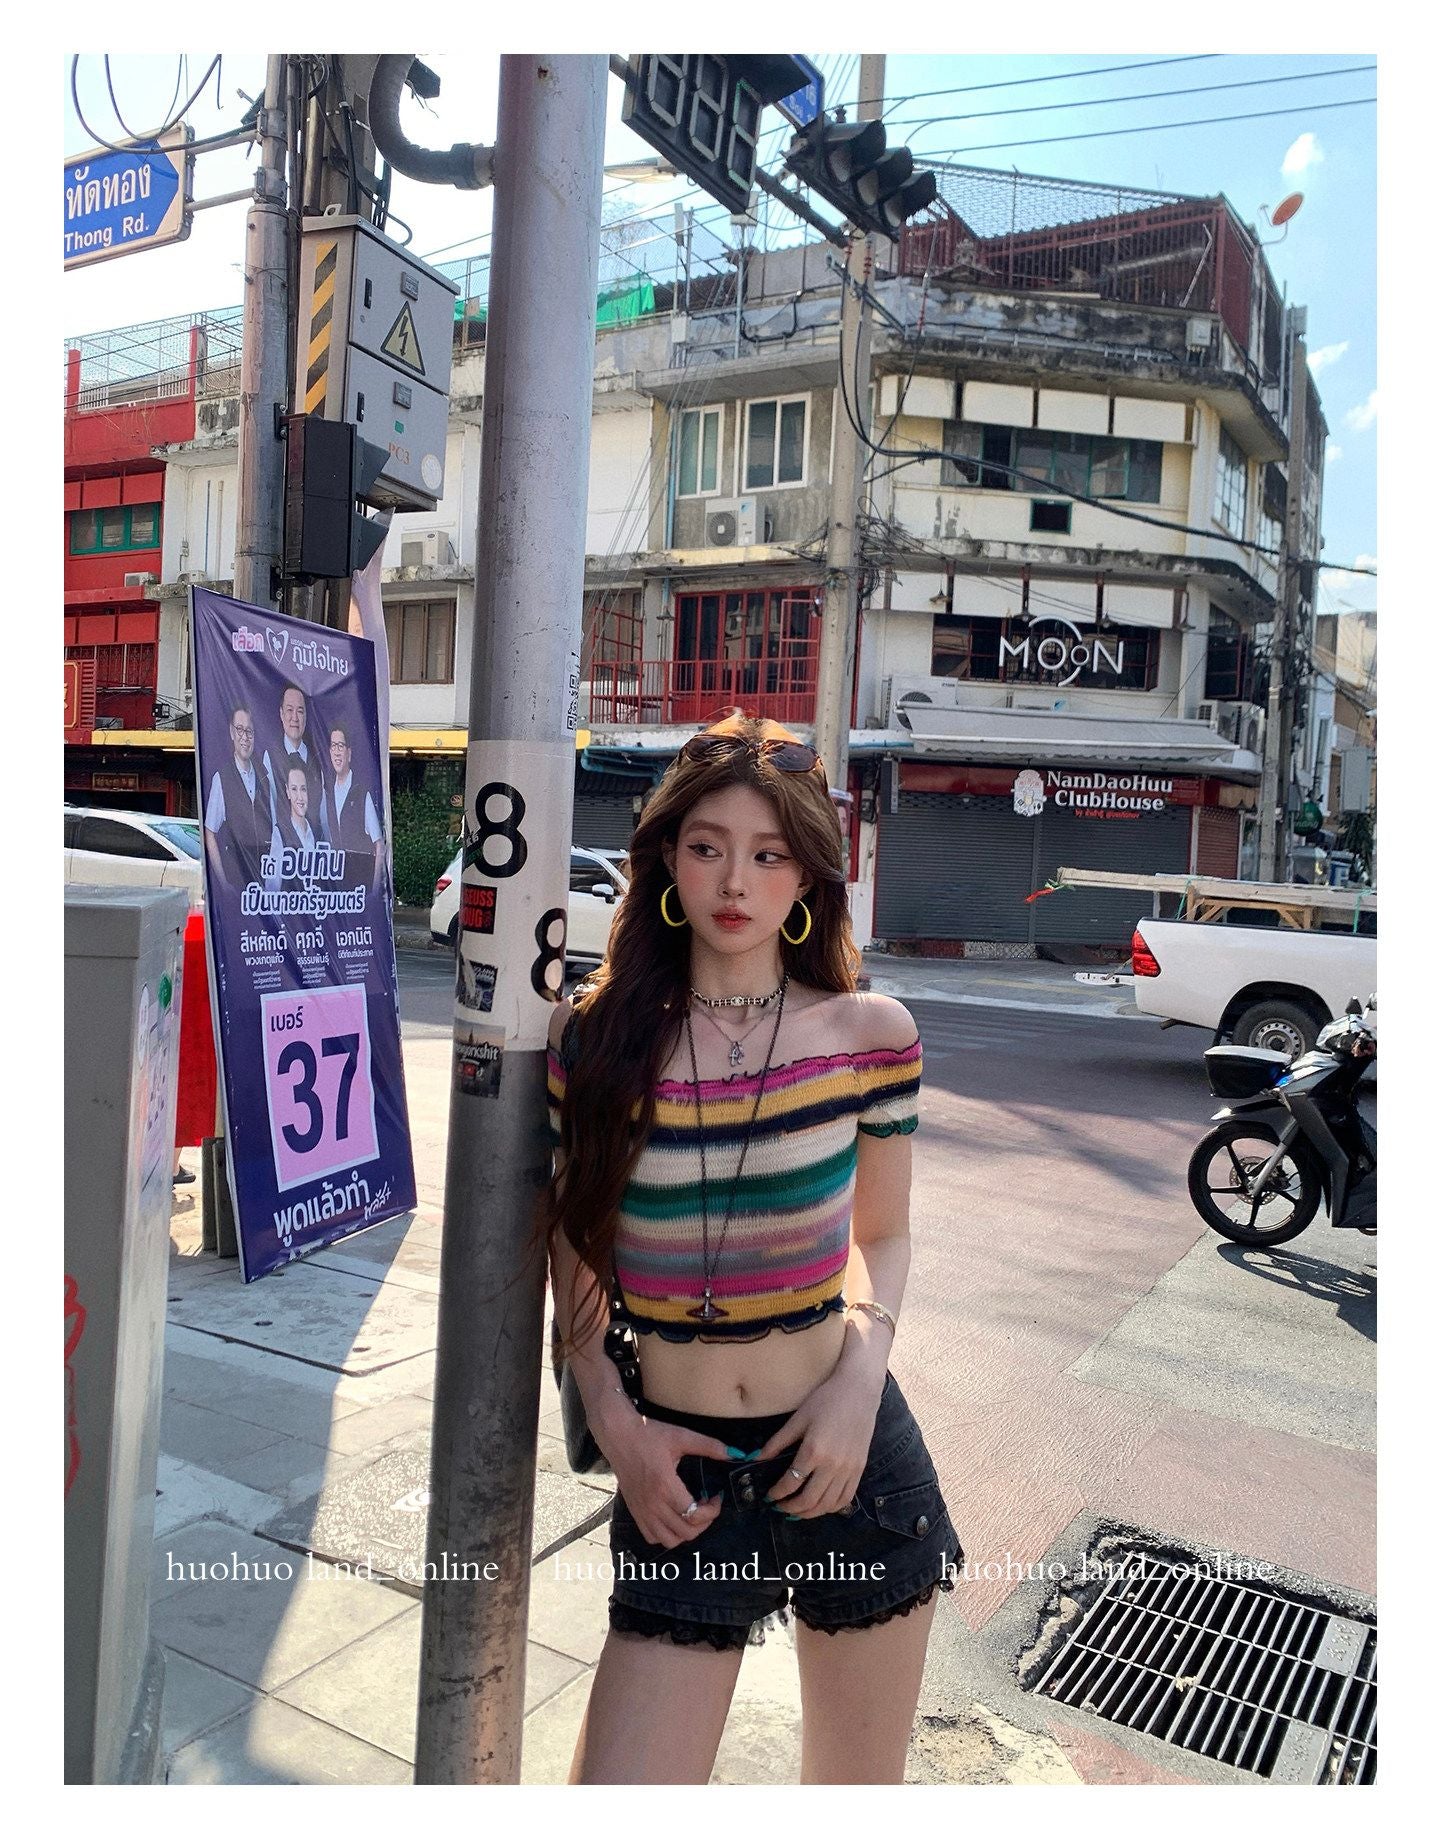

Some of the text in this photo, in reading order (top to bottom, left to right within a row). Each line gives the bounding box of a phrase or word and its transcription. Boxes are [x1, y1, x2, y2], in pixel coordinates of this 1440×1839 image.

[64, 212, 150, 253] Thong Rd.
[292, 640, 349, 676] ภูมิใจไทย
[1046, 770, 1173, 793] NamDaoHuu
[1055, 789, 1164, 811] ClubHouse
[475, 782, 528, 878] 8
[281, 843, 345, 889] อนุทิน
[241, 883, 365, 919] เป็นนายกรัฐมนตรี
[296, 924, 324, 956] ศุภจี
[336, 926, 372, 946] เอกนิติ
[271, 1006, 304, 1032] เบอร์
[277, 1033, 360, 1154] 37
[273, 1170, 371, 1248] พูดแล้วทำ
